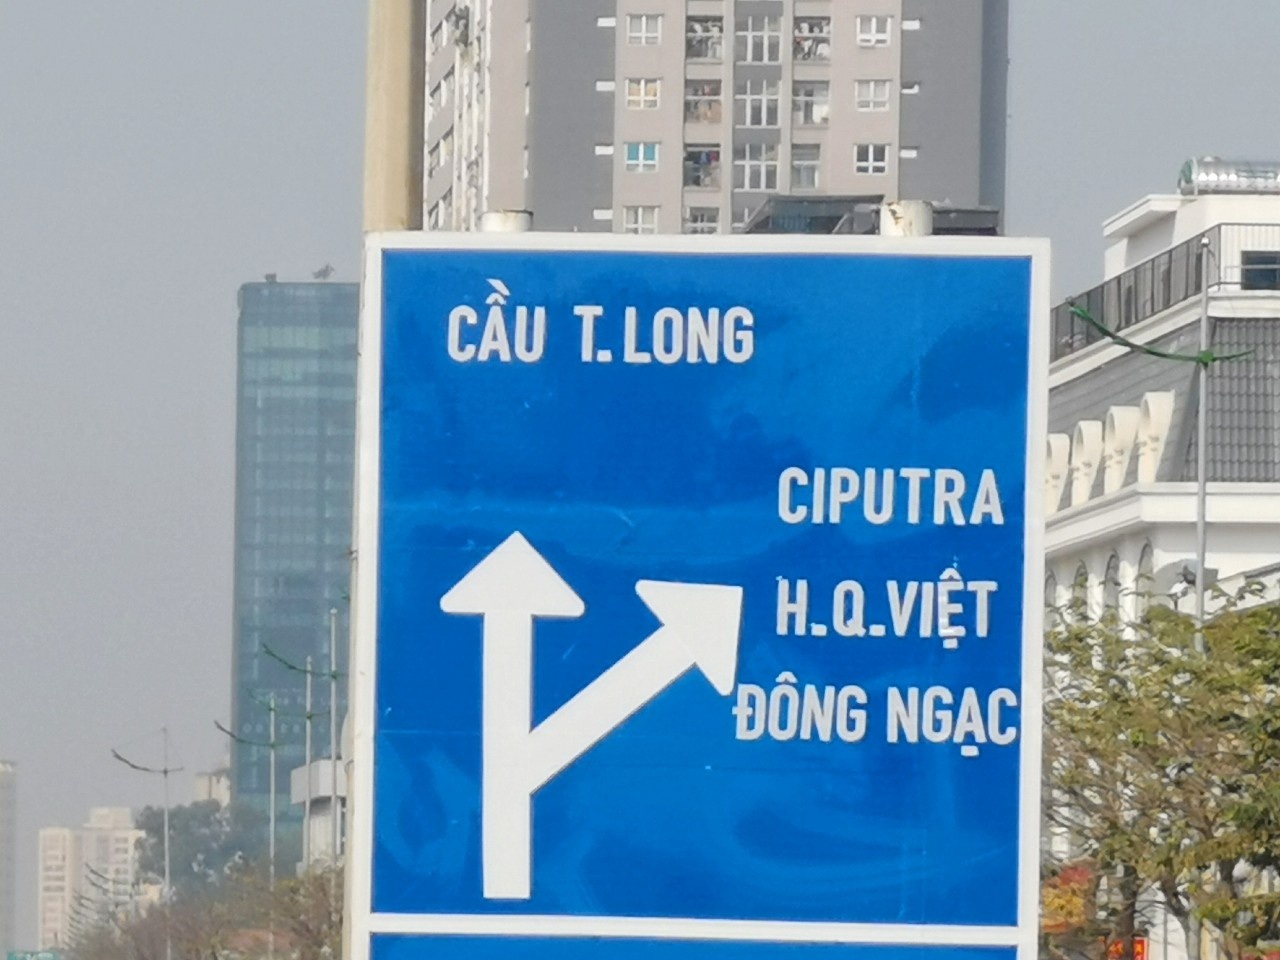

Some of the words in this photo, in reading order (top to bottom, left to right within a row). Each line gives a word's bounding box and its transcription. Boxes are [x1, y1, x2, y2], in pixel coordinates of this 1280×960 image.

[448, 279, 545, 362] CẦU
[778, 466, 1004, 526] CIPUTRA
[775, 566, 998, 649] H.Q.VIỆT
[732, 670, 868, 743] ĐÔNG
[886, 686, 1017, 757] NGẠC
